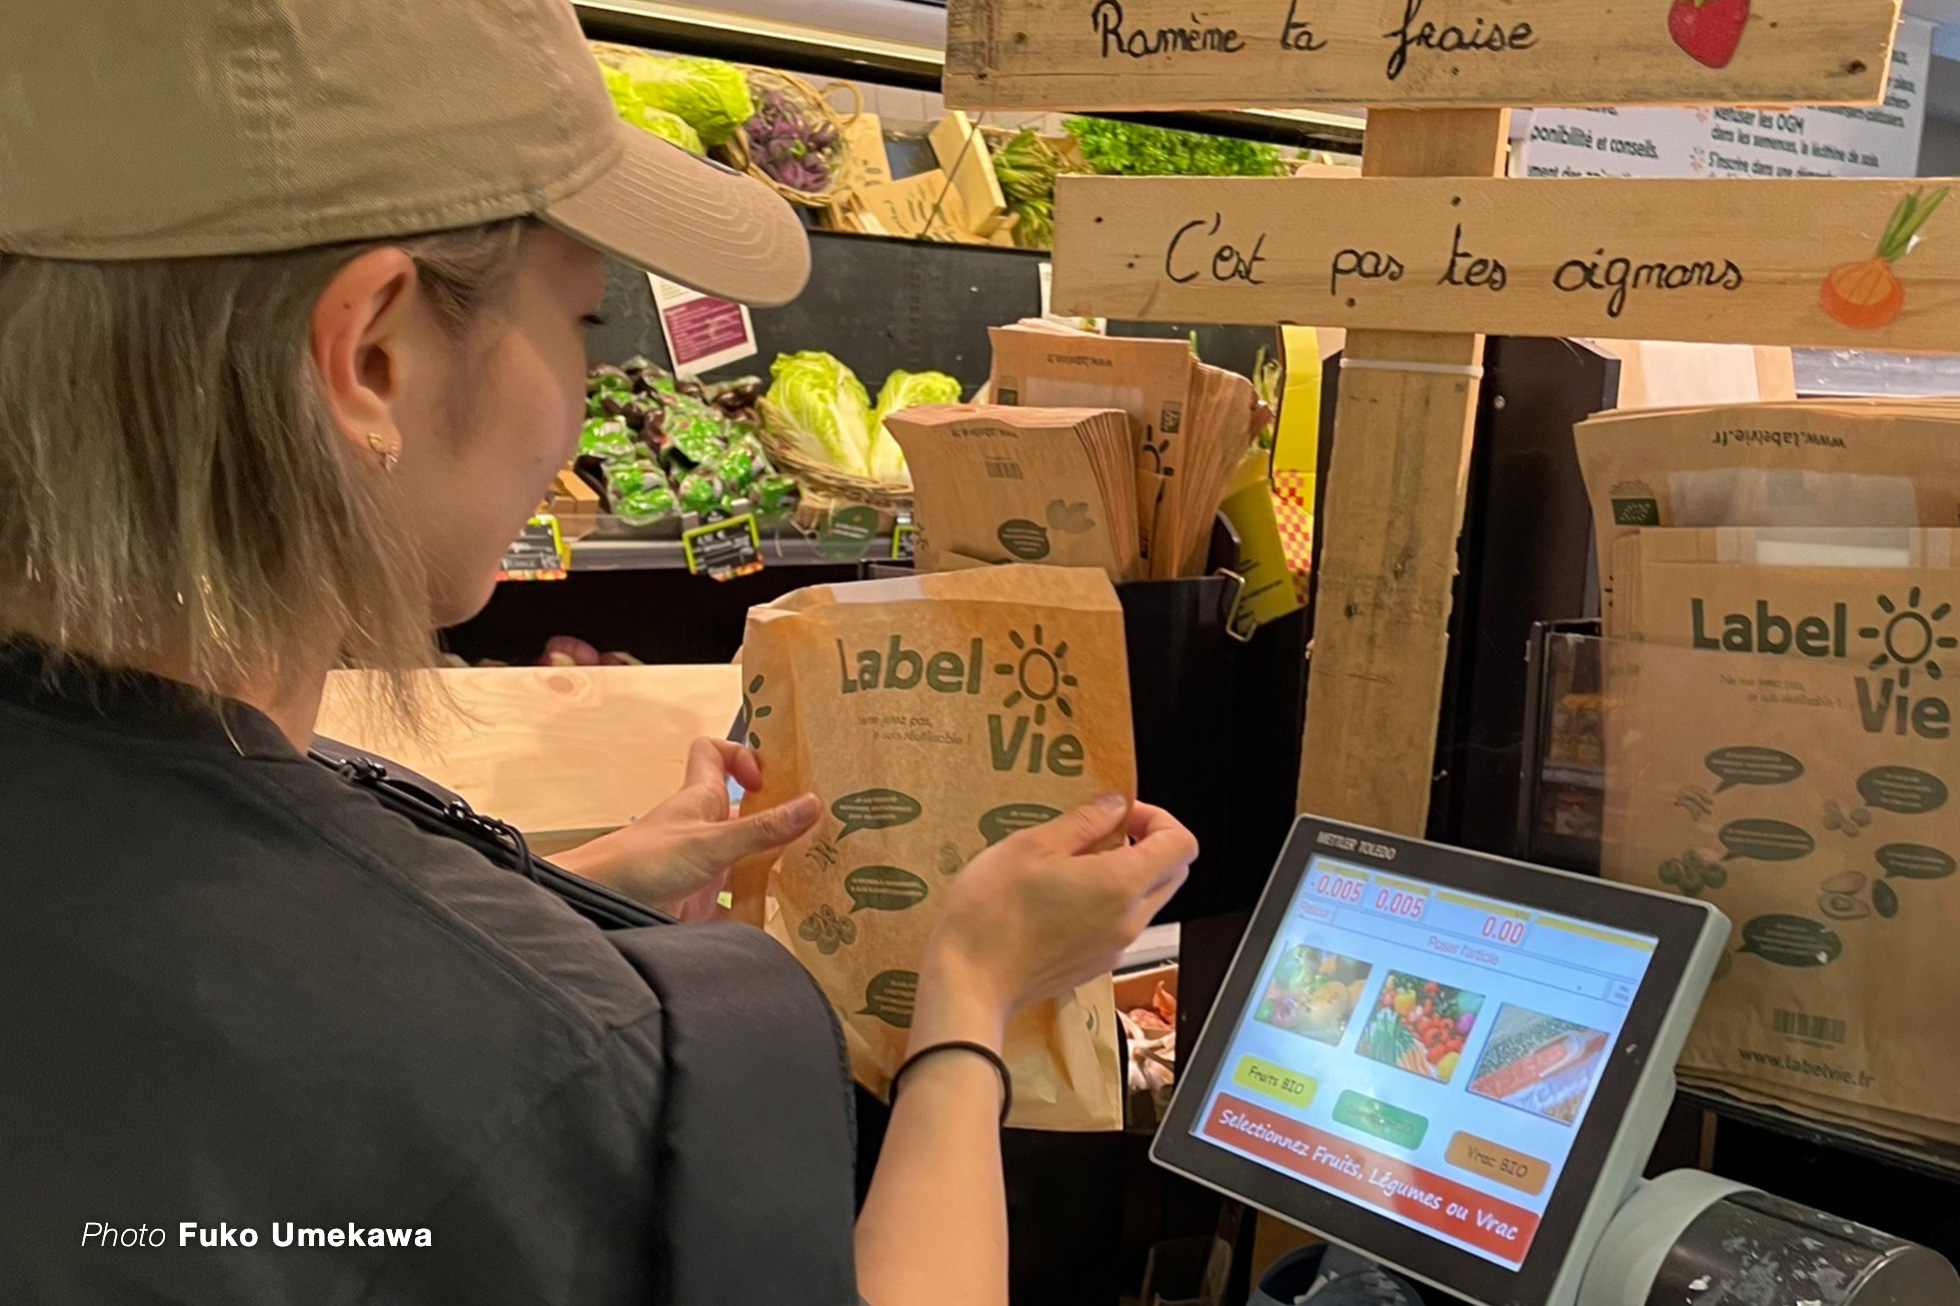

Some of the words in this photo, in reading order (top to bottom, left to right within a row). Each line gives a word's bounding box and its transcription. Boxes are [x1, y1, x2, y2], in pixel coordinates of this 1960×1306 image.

[1092, 0, 1245, 58] Ramène
[1281, 0, 1328, 52] ta
[1383, 0, 1538, 80] fraise
[1165, 212, 1267, 286] C'est
[1331, 246, 1404, 296] pas
[1437, 222, 1507, 291] tes
[1691, 597, 1847, 659] Label
[835, 633, 984, 695] Label
[1853, 675, 1951, 740] Vie
[987, 713, 1085, 778] Vie
[1316, 831, 1359, 852] METTLER
[1358, 839, 1397, 861] TOLEDO
[1375, 888, 1426, 918] 0.005
[1482, 915, 1525, 944] 0.00
[1247, 1064, 1279, 1088] Fruits
[1280, 1076, 1305, 1095] BIO
[1217, 1109, 1309, 1157] Selectionnez
[1311, 1146, 1363, 1180] Fruits,
[1368, 1167, 1443, 1211] Légumes
[1446, 1203, 1467, 1222] ou
[1476, 1208, 1519, 1240] Vrac
[1467, 1144, 1496, 1167] Vrac
[1499, 1158, 1529, 1178] BIO
